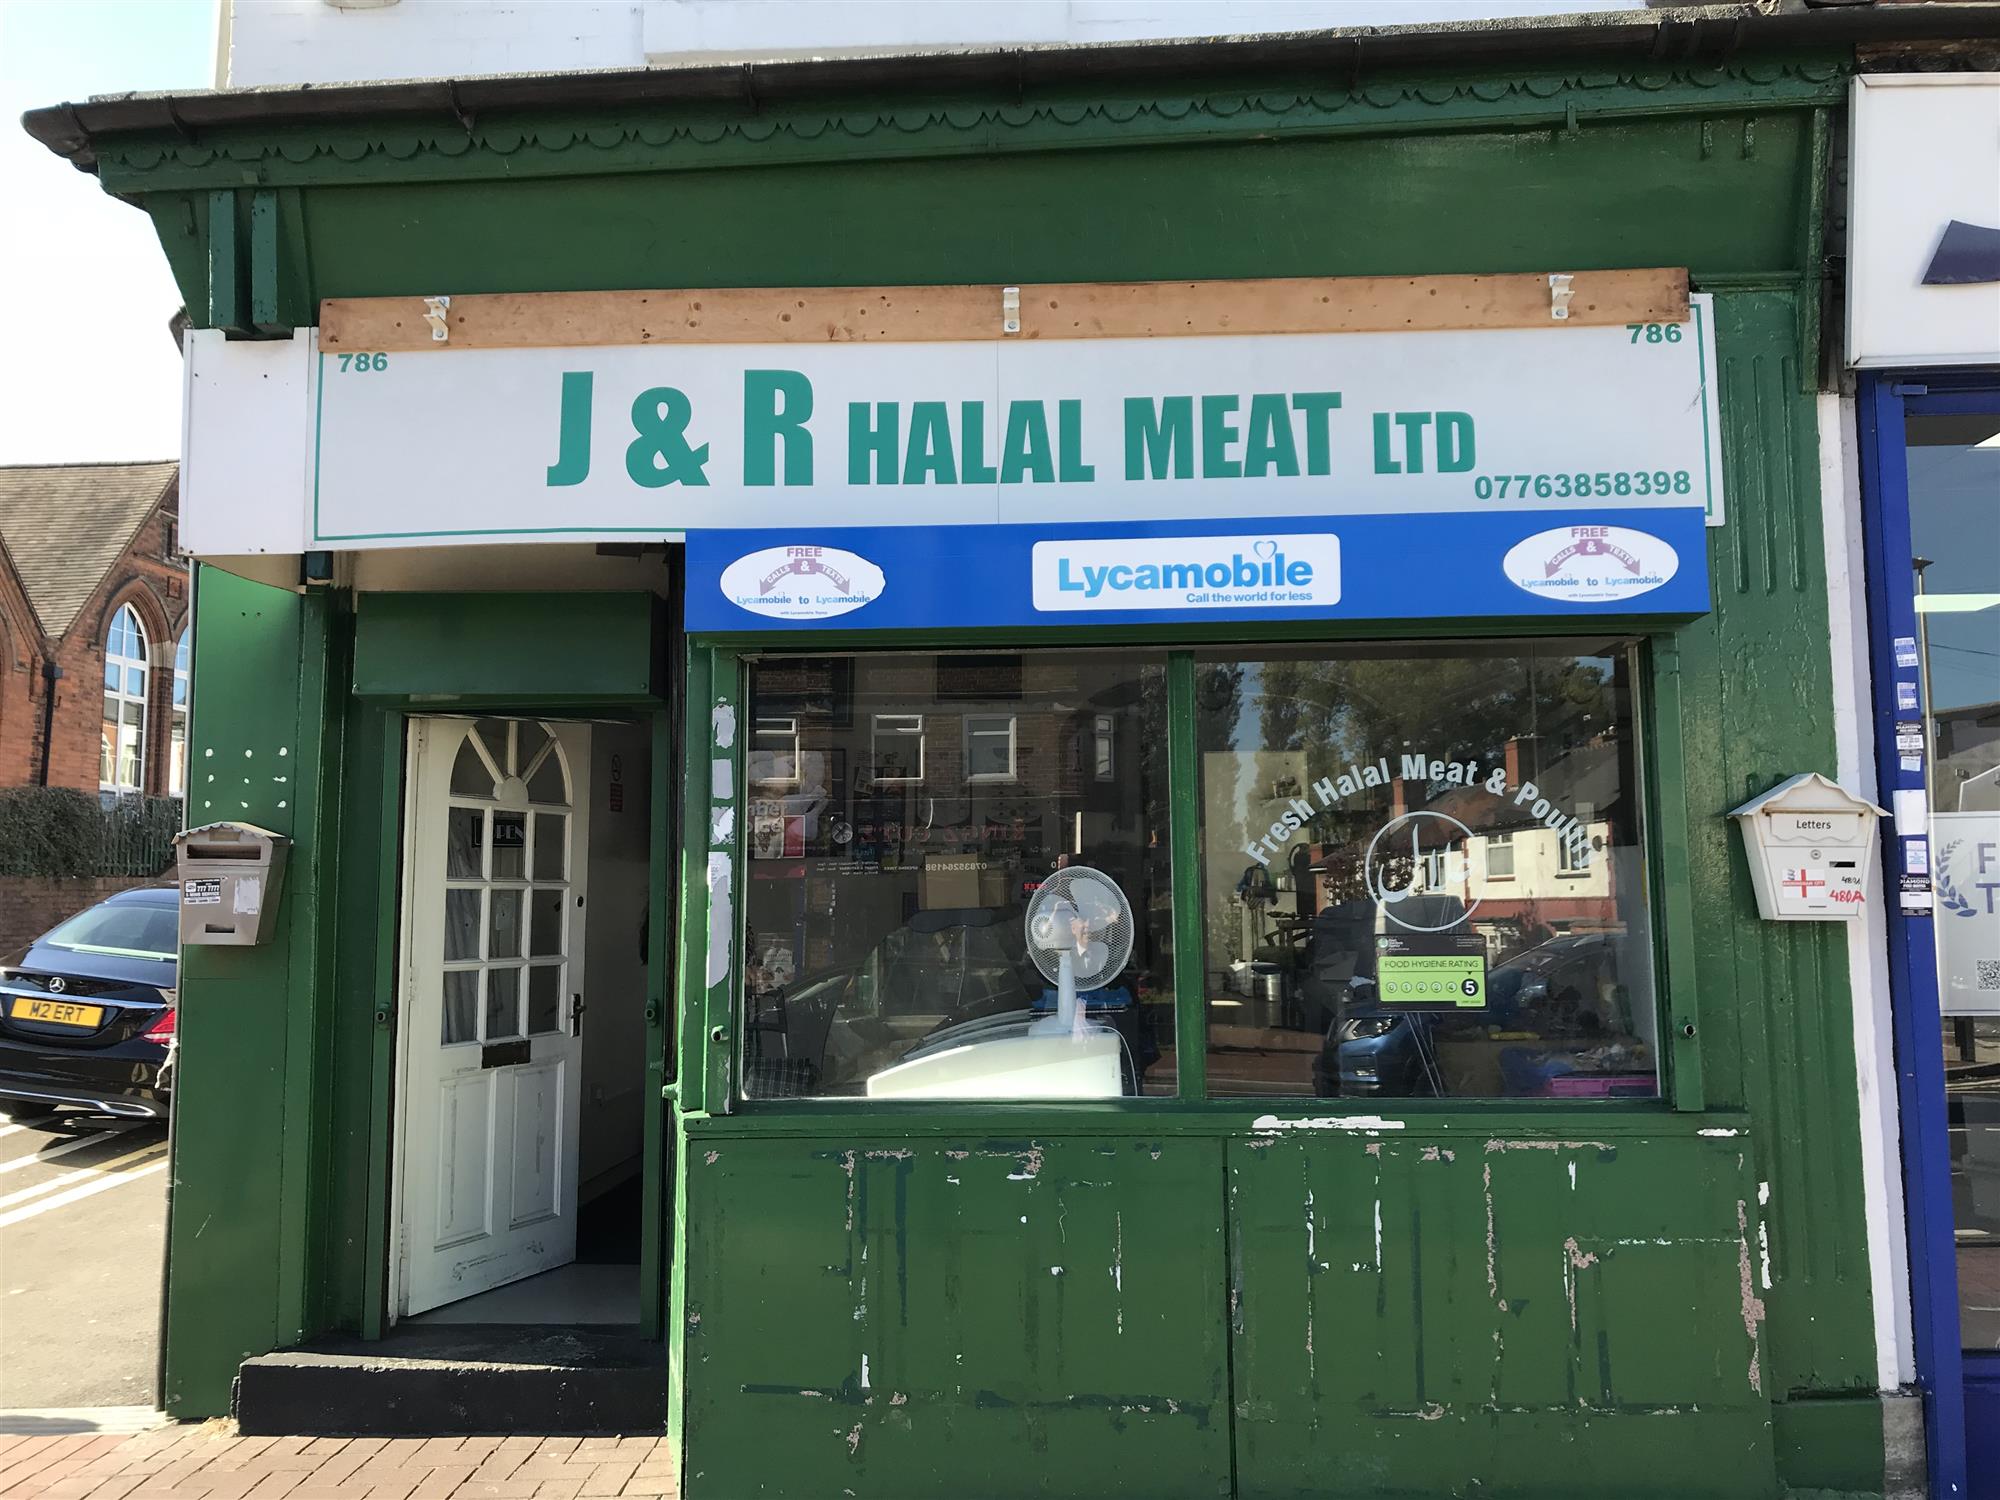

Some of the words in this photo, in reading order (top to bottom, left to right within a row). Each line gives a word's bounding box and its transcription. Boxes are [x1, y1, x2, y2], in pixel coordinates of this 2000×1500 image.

[1627, 323, 1682, 344] 786
[338, 352, 388, 373] 786
[547, 371, 593, 487] J
[625, 387, 709, 488] &
[744, 369, 813, 486] R
[848, 398, 1095, 486] HALAL
[1124, 392, 1342, 481] MEAT
[1373, 411, 1477, 474] LTD
[1474, 470, 1691, 500] 07763858398
[1571, 527, 1608, 538] FREE
[787, 547, 823, 557] FREE
[1587, 541, 1598, 552] &
[766, 565, 791, 584] CALLS
[801, 560, 810, 572] &
[822, 565, 846, 585] TEXTS
[1058, 552, 1314, 598] Lycamobile
[1522, 577, 1580, 587] Lycamobile
[1587, 577, 1599, 586] to
[1605, 575, 1664, 585] Lycamobile
[736, 594, 792, 605] Lycamobile
[798, 596, 810, 605] to
[816, 594, 871, 604] Lycamobile
[1186, 592, 1210, 603] Call
[1212, 592, 1232, 602] the
[1234, 591, 1268, 602] world
[1270, 591, 1287, 601] for
[1289, 591, 1313, 601] less
[1246, 798, 1316, 866] Fresh
[1312, 757, 1391, 808] Halal
[1401, 753, 1479, 788] Meat
[1485, 766, 1508, 797] &
[1513, 780, 1599, 869] Poultry
[1795, 820, 1832, 831] Letters
[1829, 889, 1866, 903] 480A
[1384, 960, 1410, 968] FOOD
[1411, 960, 1449, 968] HYGIENE
[1449, 960, 1479, 968] RATING
[1464, 980, 1476, 995] 5
[29, 1001, 52, 1019] M2
[53, 1003, 86, 1023] ERT
